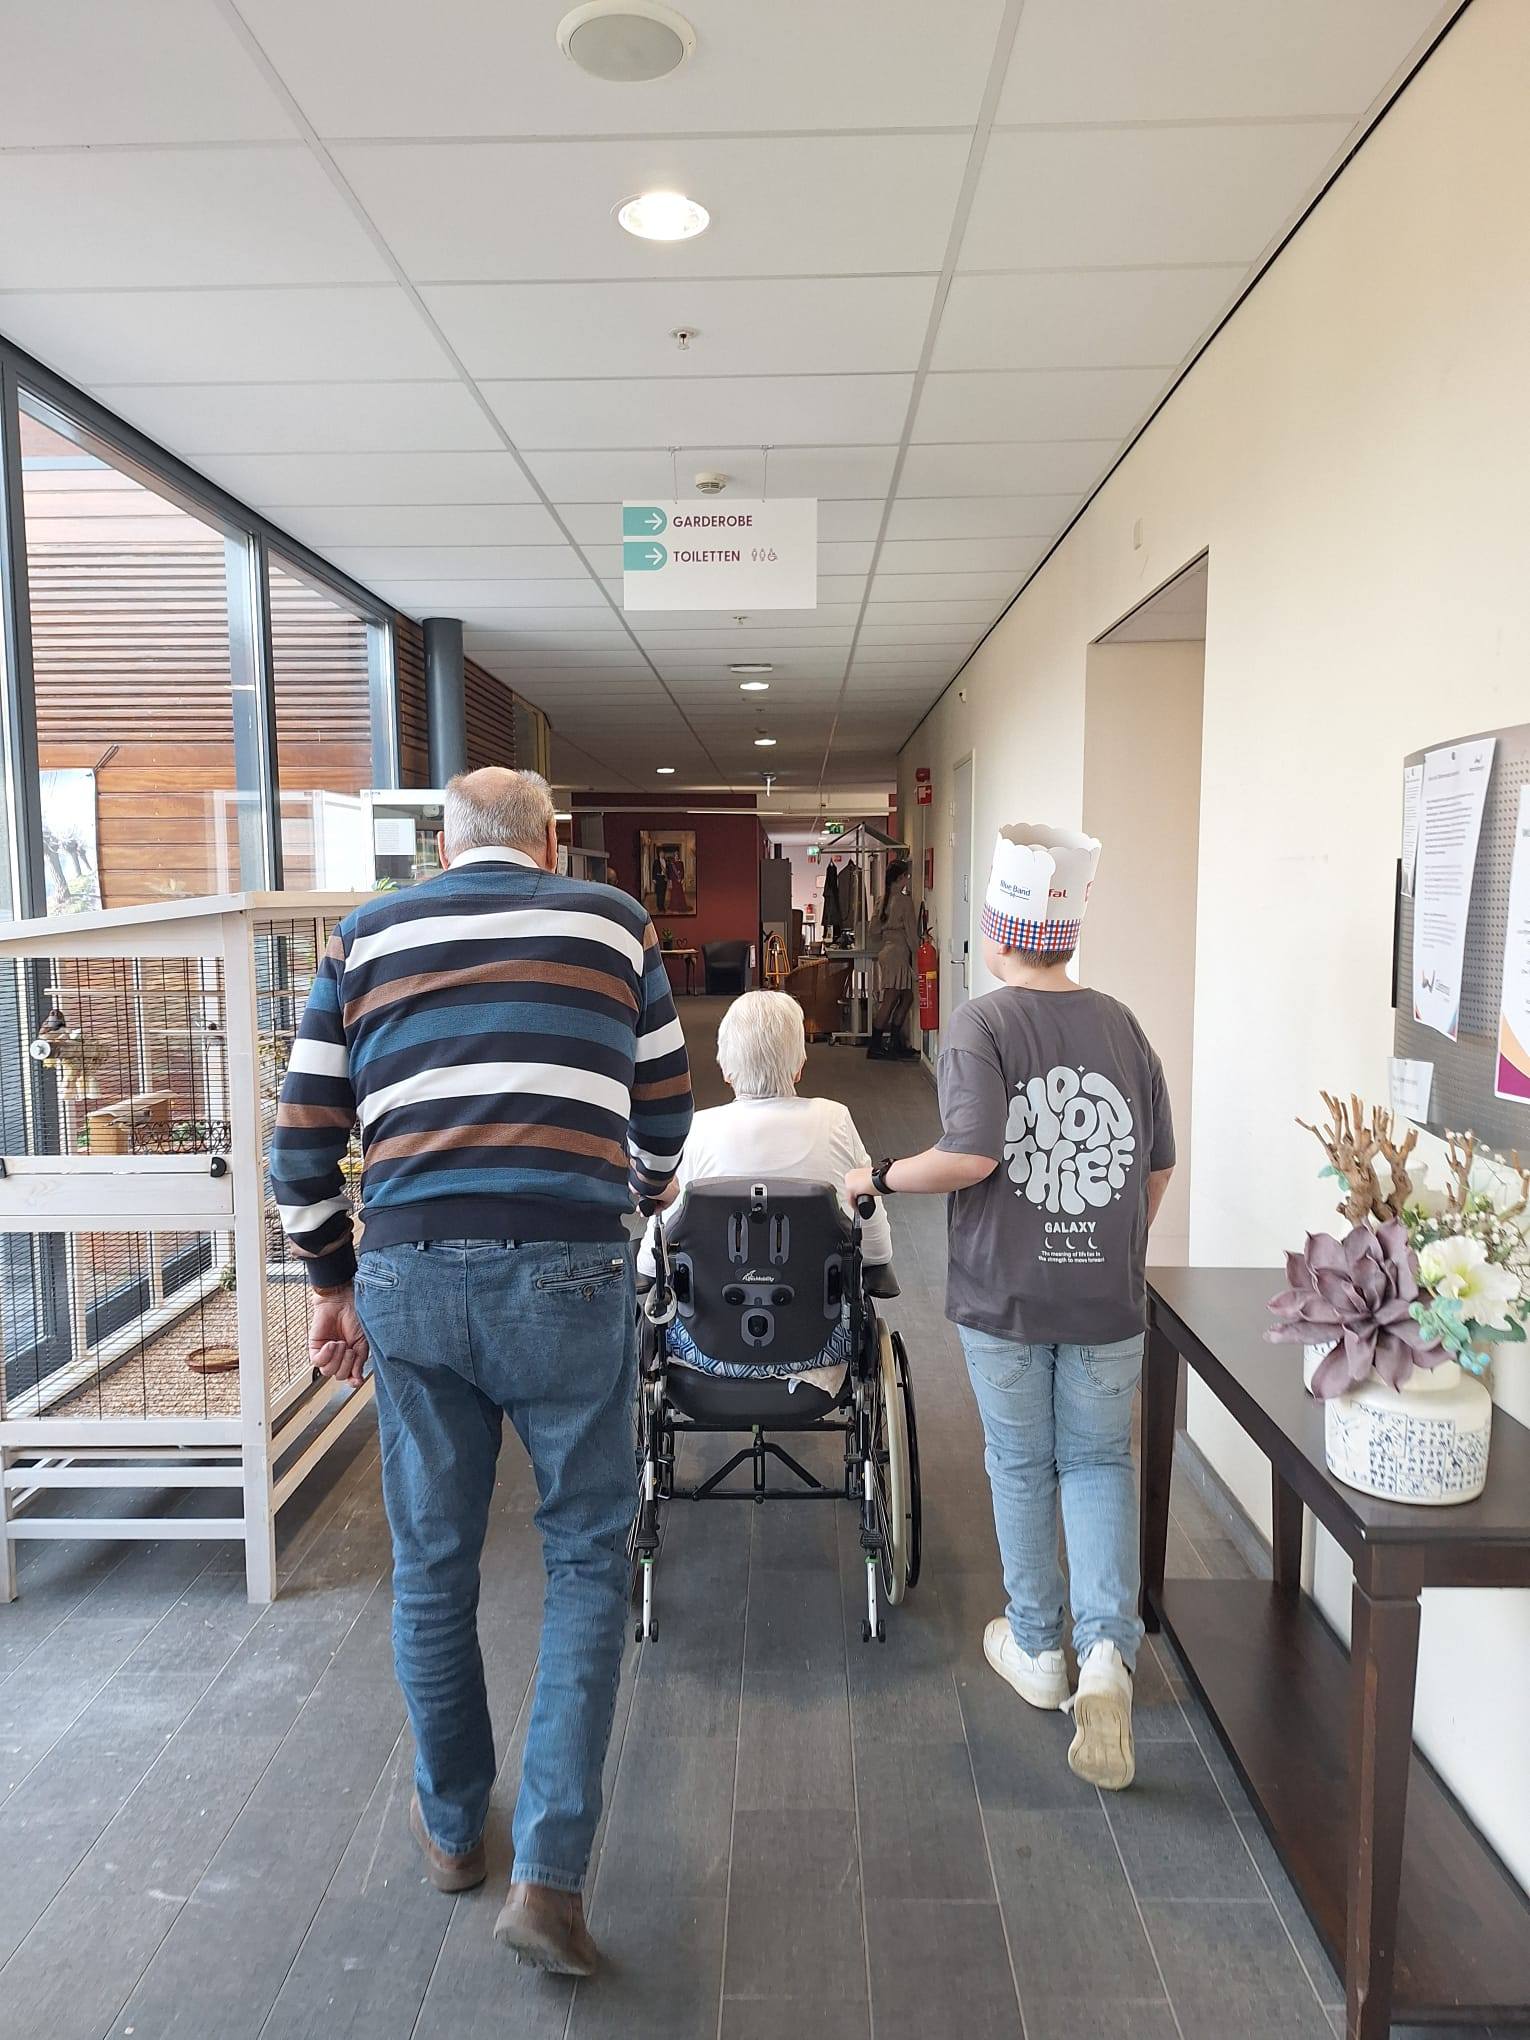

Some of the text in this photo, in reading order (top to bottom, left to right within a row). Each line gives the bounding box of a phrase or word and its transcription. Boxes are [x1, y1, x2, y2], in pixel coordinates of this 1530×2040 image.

[672, 515, 753, 528] GARDEROBE
[673, 550, 741, 562] TOILETTEN
[1013, 885, 1031, 896] Band
[1004, 1065, 1134, 1151] MOON
[1044, 1221, 1097, 1234] GALAXY
